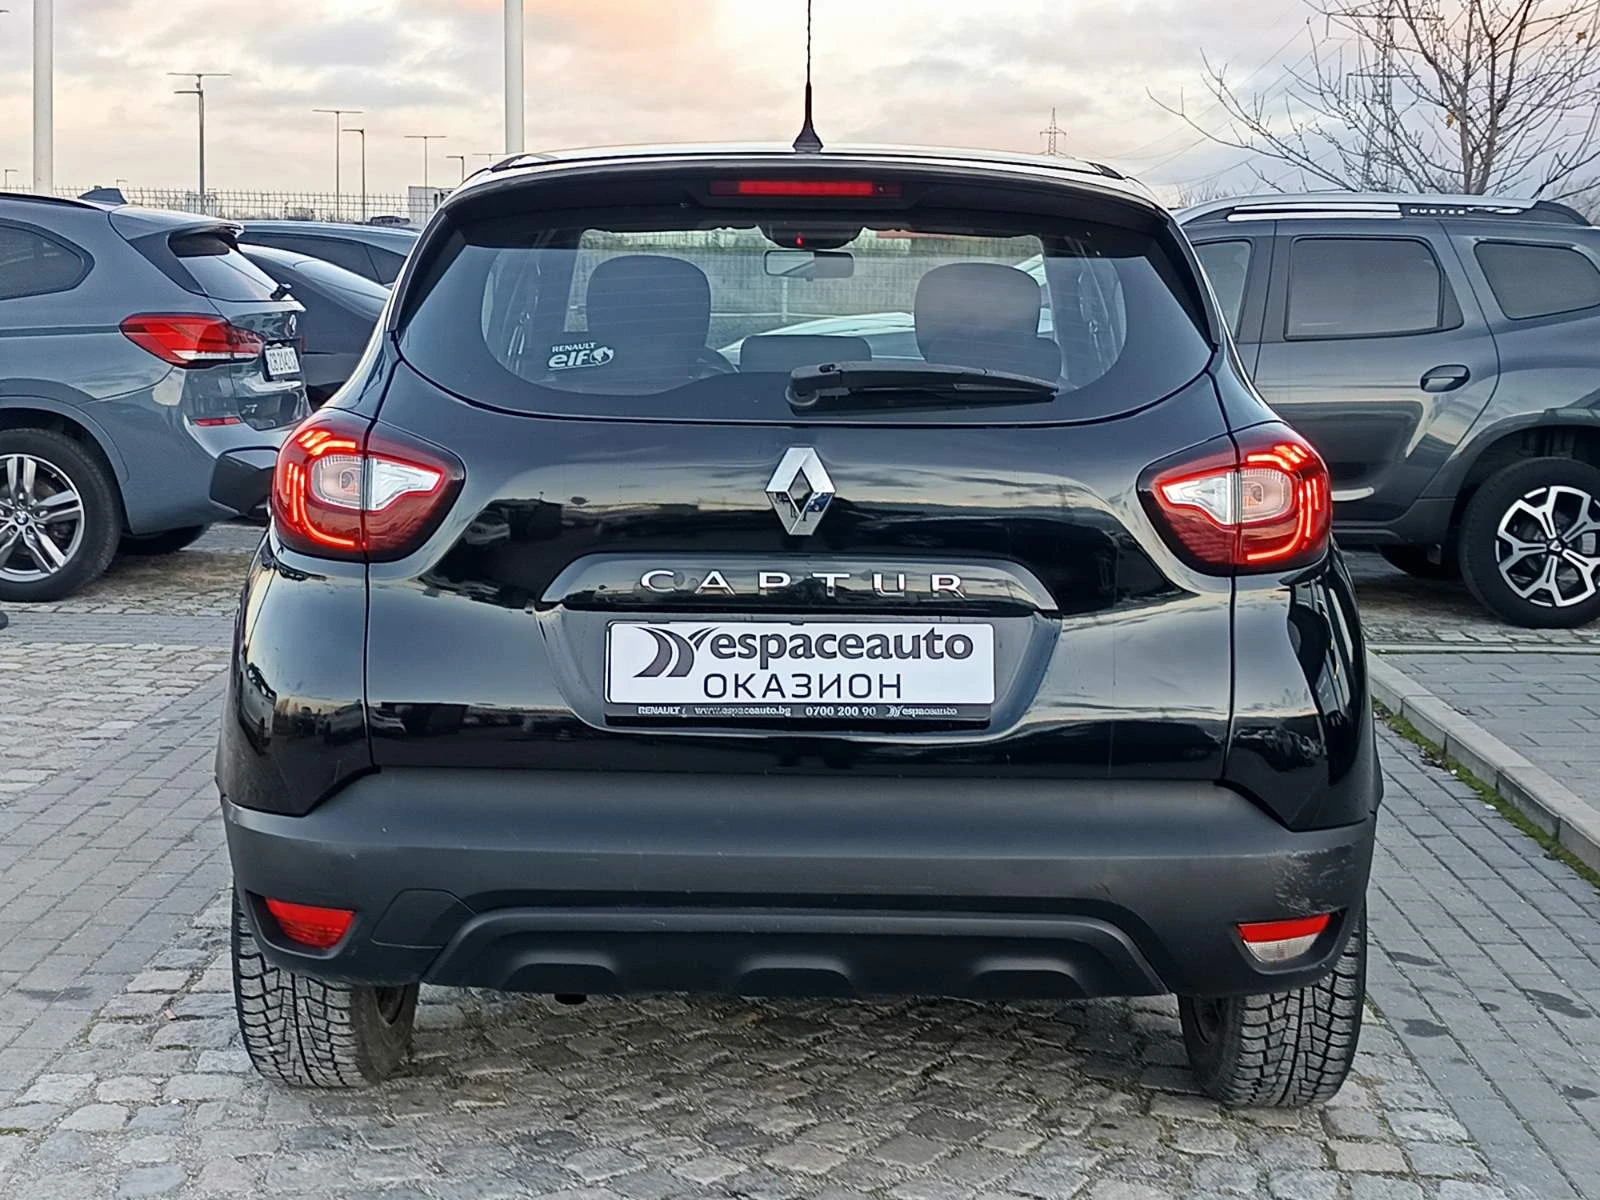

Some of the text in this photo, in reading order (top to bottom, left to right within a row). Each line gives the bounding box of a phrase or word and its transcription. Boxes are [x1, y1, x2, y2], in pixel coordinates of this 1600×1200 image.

[552, 342, 597, 353] RENAULT
[548, 350, 590, 367] elf
[640, 569, 966, 598] CAPTUR
[710, 627, 974, 670] espaceauto
[703, 674, 902, 699] ОКАЗИОН
[638, 706, 680, 715] RENAULT
[805, 706, 834, 716] 0700
[837, 706, 859, 716] 200
